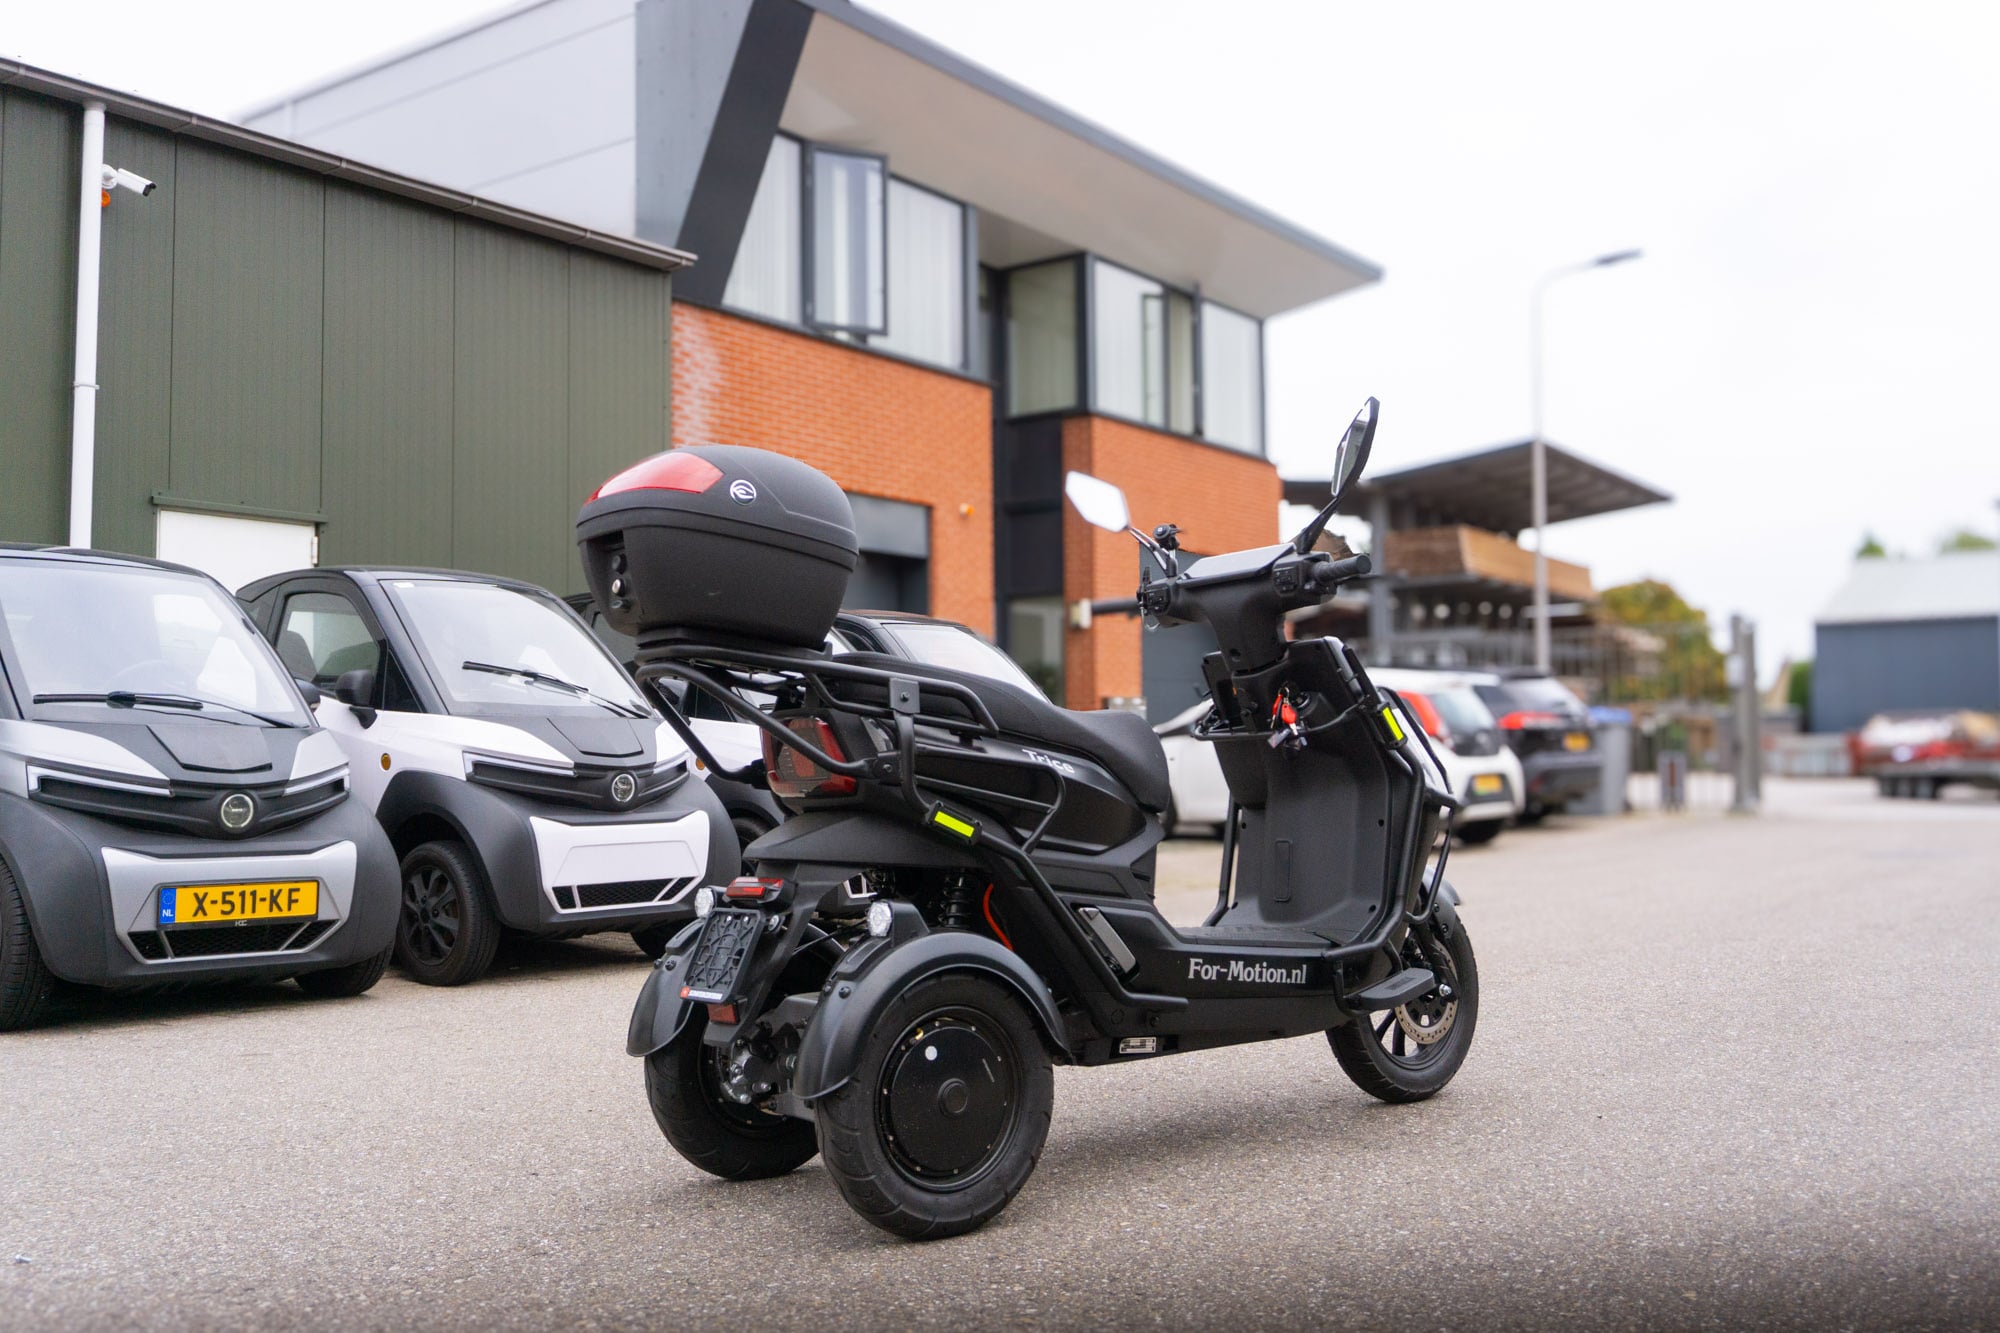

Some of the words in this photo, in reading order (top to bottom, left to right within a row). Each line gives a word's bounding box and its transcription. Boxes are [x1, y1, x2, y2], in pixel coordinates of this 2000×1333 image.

[1021, 748, 1075, 773] Trice
[162, 909, 174, 917] NL
[192, 887, 301, 917] X-511-KF
[1188, 958, 1307, 984] For-Motion.nl
